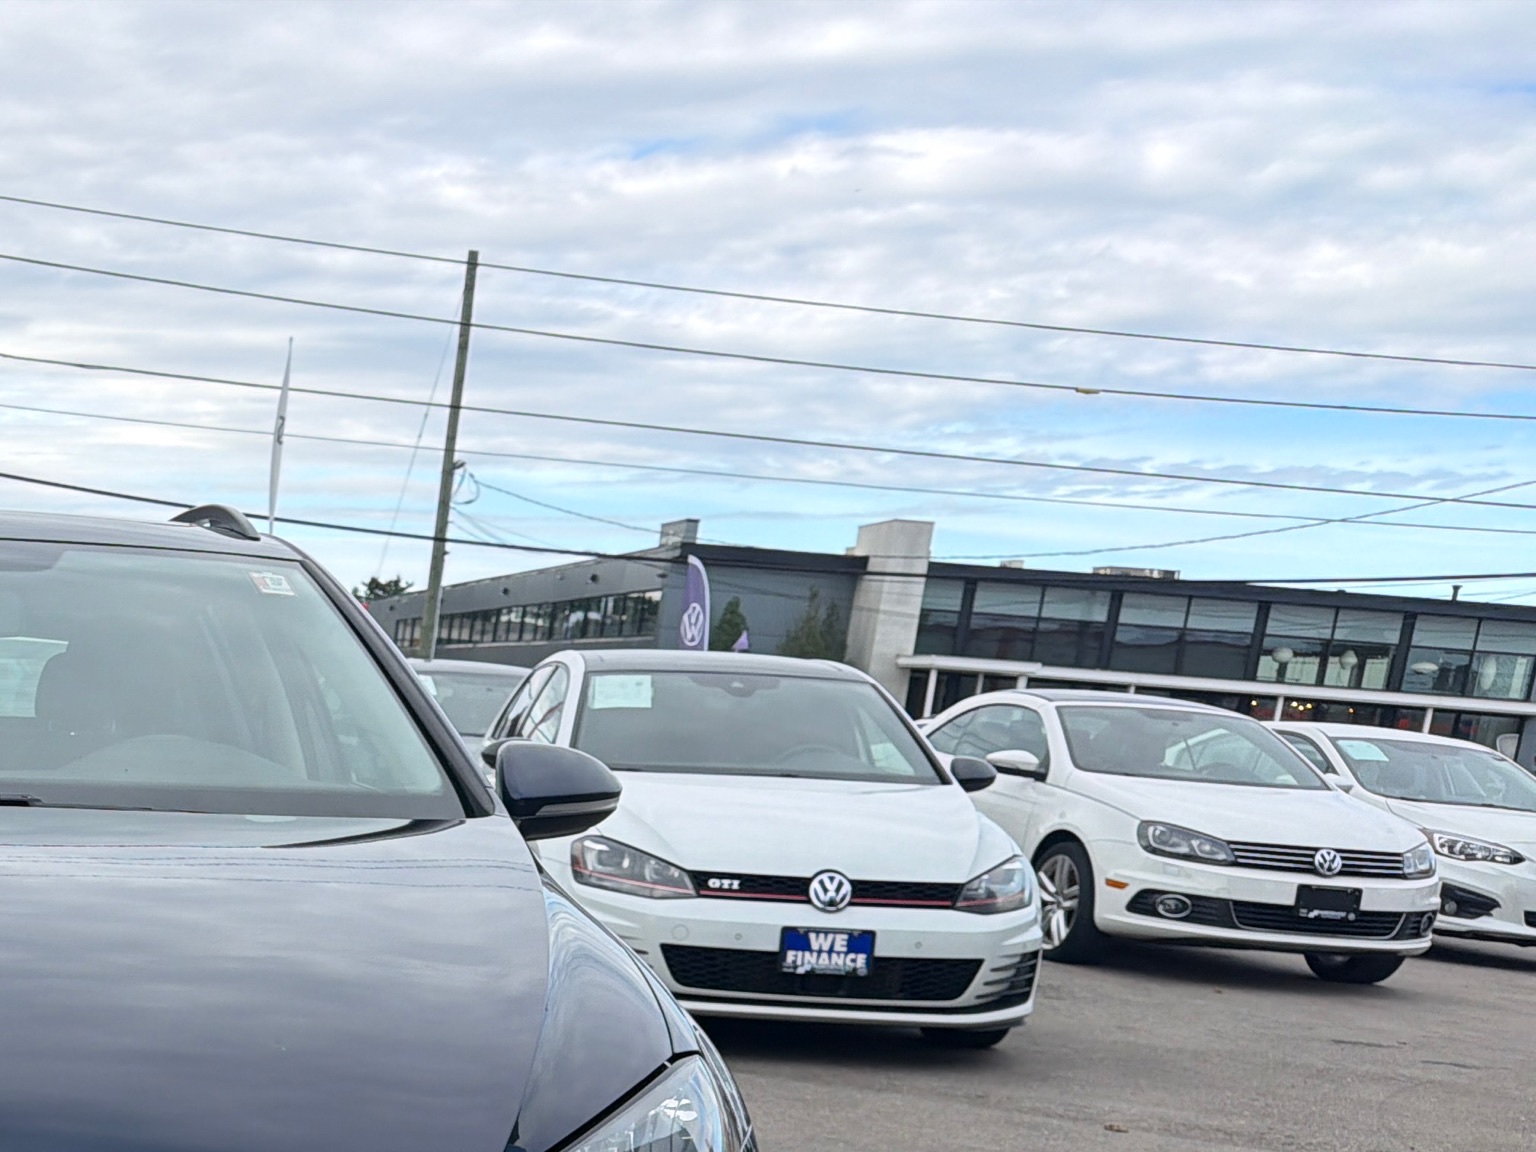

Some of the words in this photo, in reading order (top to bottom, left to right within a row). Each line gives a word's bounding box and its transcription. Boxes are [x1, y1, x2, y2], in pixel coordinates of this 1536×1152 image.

[707, 878, 741, 890] GTI
[808, 932, 849, 952] WE
[785, 949, 868, 968] FINANCE
